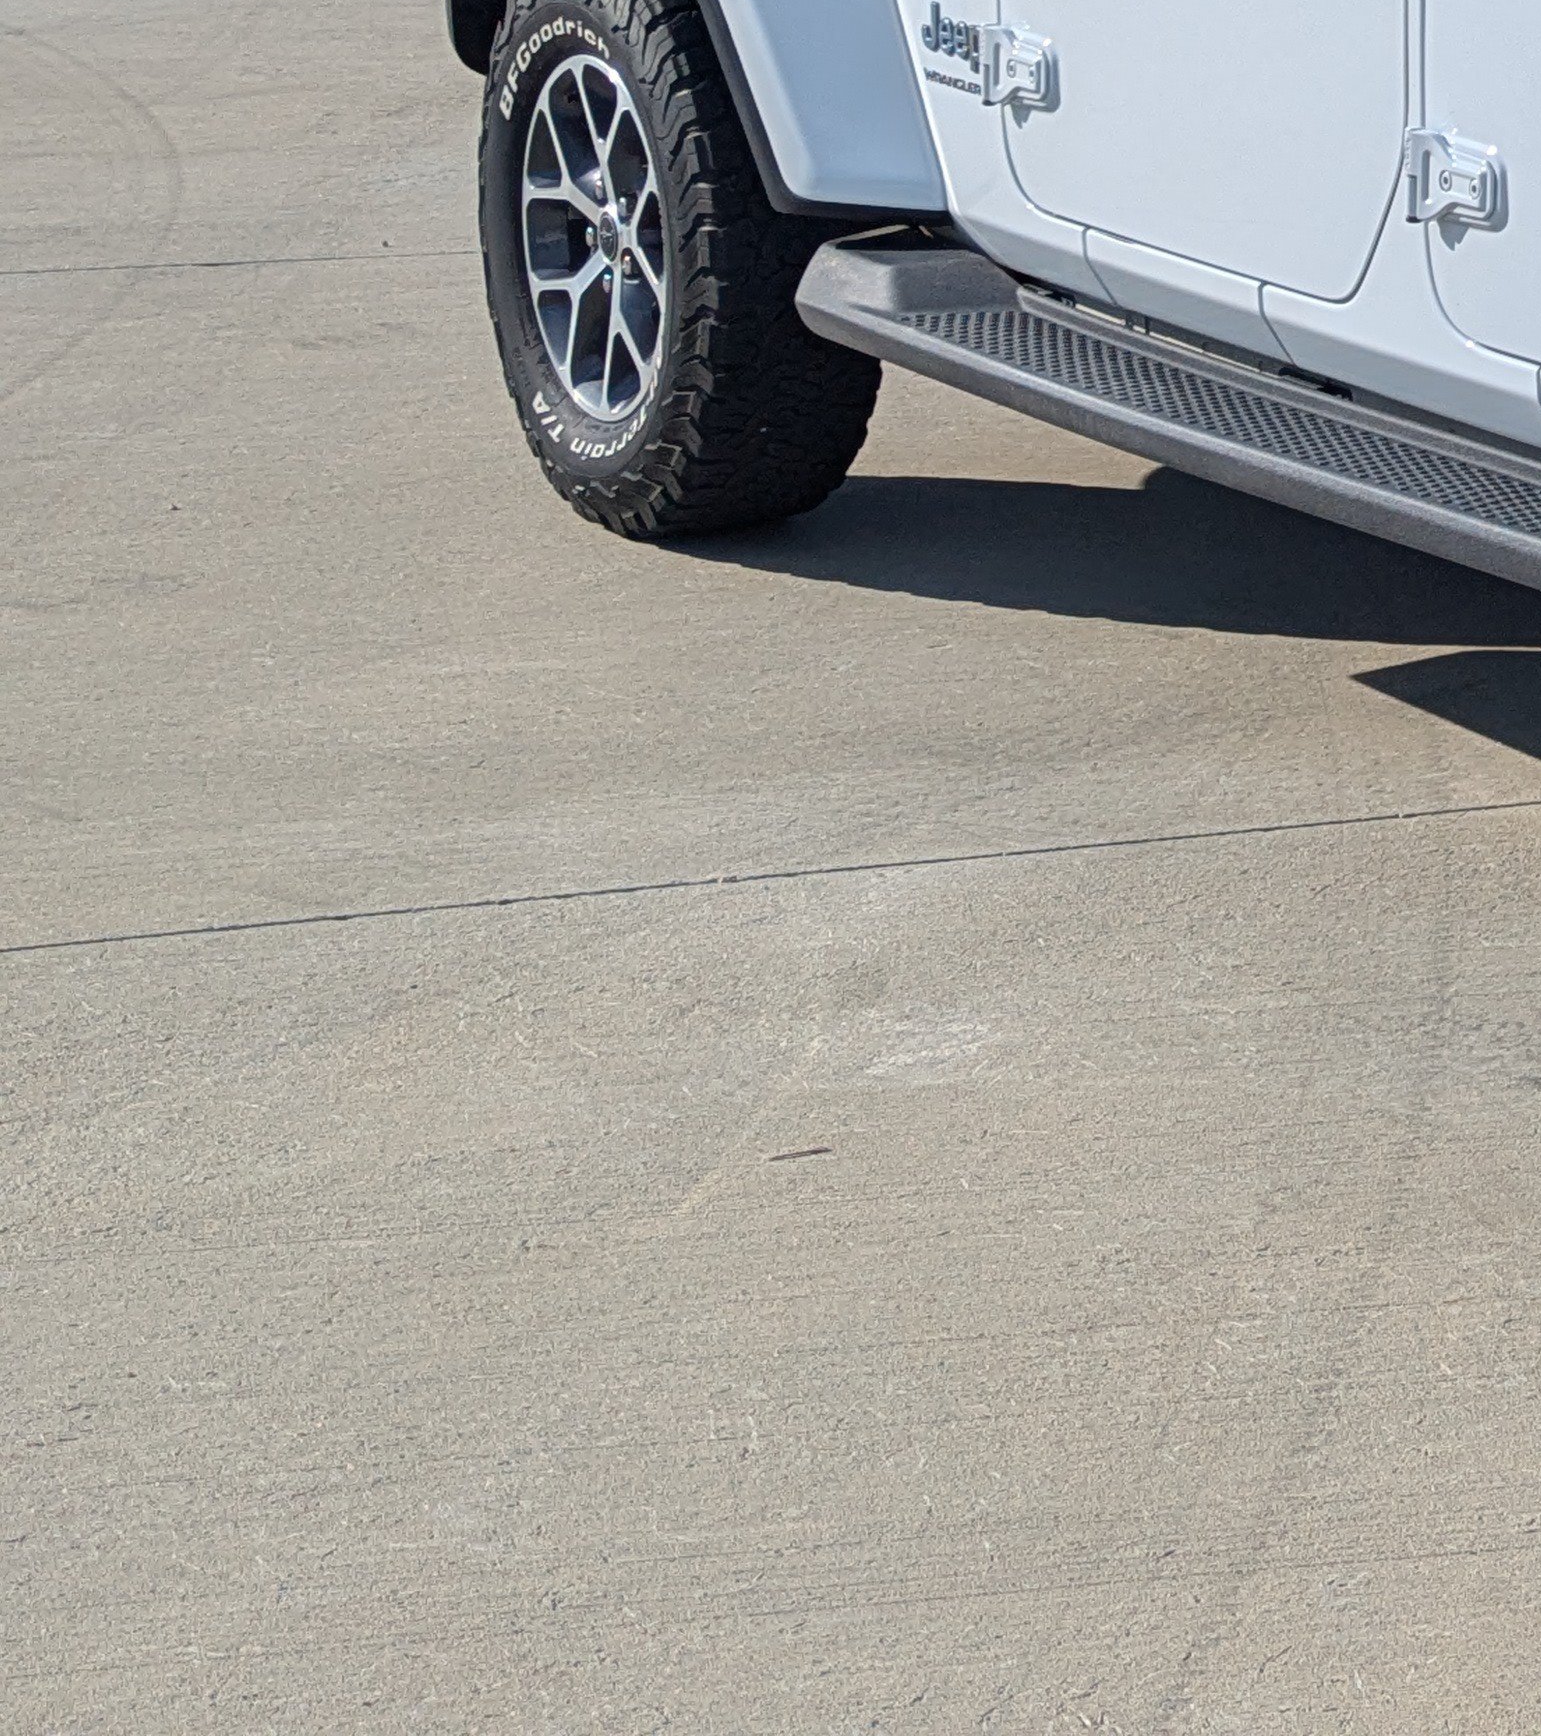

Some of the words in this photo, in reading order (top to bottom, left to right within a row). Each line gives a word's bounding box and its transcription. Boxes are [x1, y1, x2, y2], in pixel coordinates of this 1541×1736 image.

[499, 15, 610, 121] BFGoodrich
[921, 0, 981, 75] Jeep
[923, 66, 982, 96] WRANGLER
[532, 390, 564, 443] T/A
